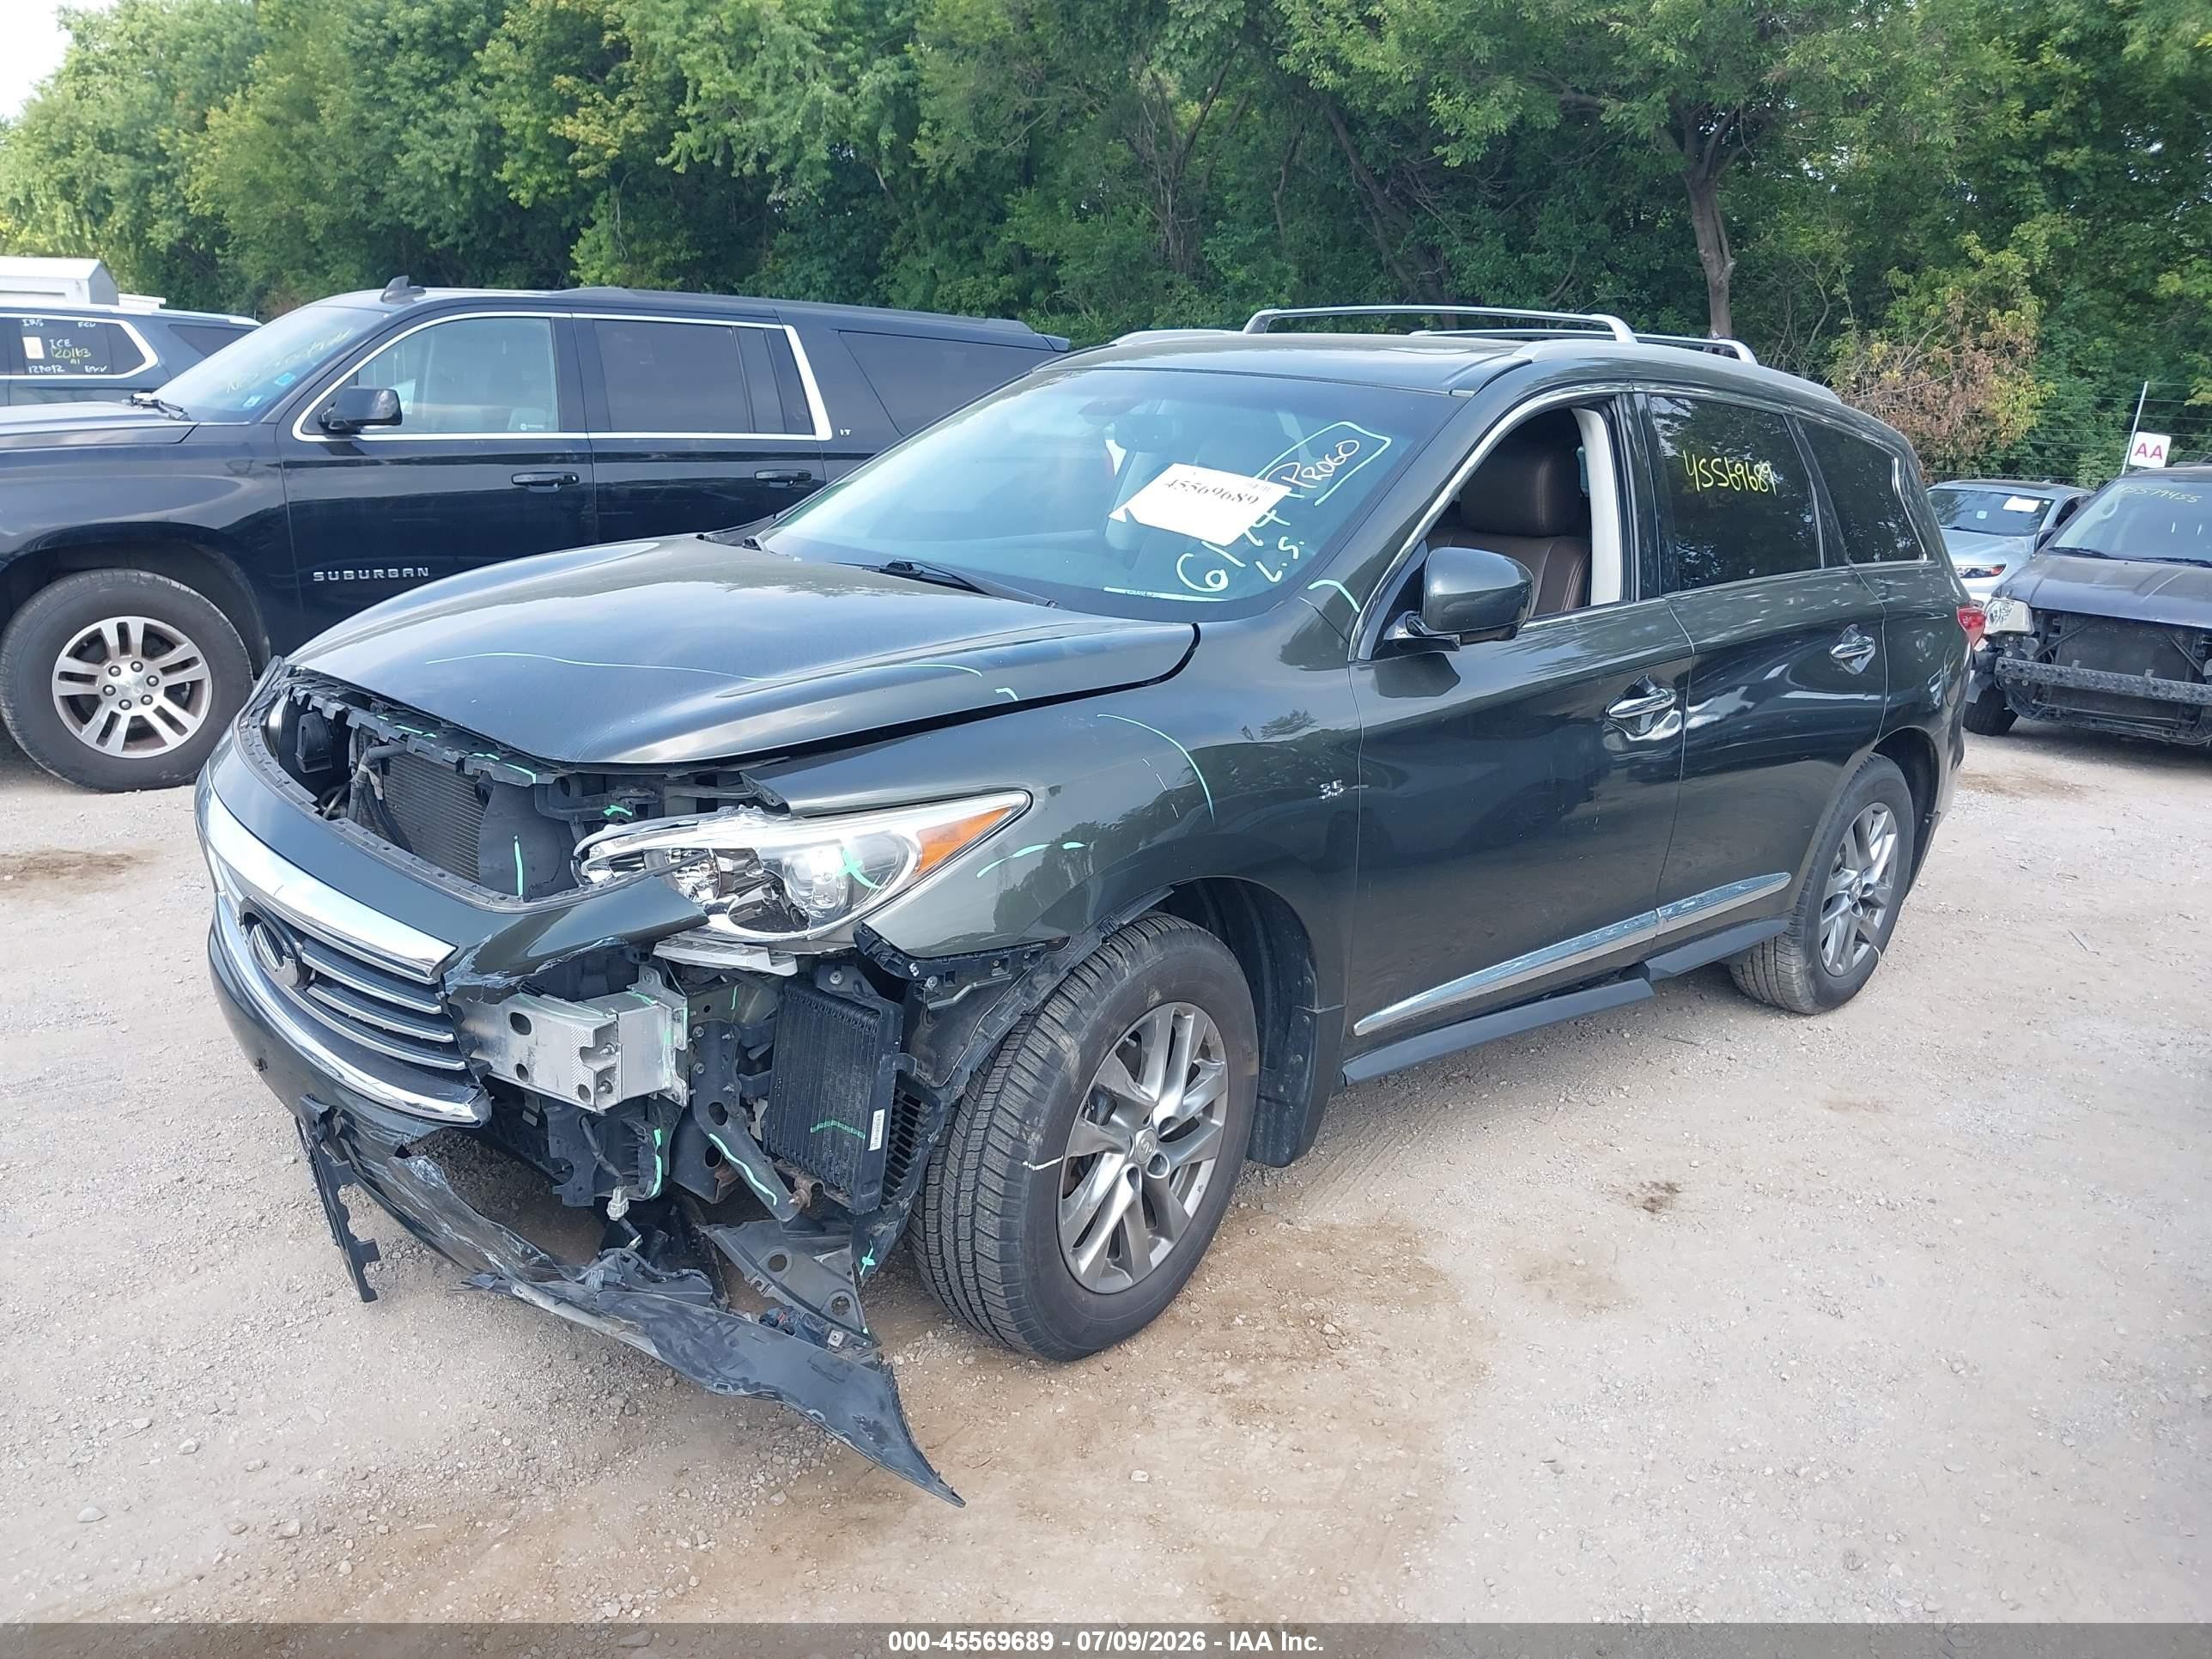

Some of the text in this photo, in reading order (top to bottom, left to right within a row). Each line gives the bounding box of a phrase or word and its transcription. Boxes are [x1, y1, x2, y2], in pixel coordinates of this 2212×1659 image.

[2134, 442, 2163, 460] AA
[1682, 449, 1778, 497] 45569689
[313, 567, 429, 581] SUBURBAN
